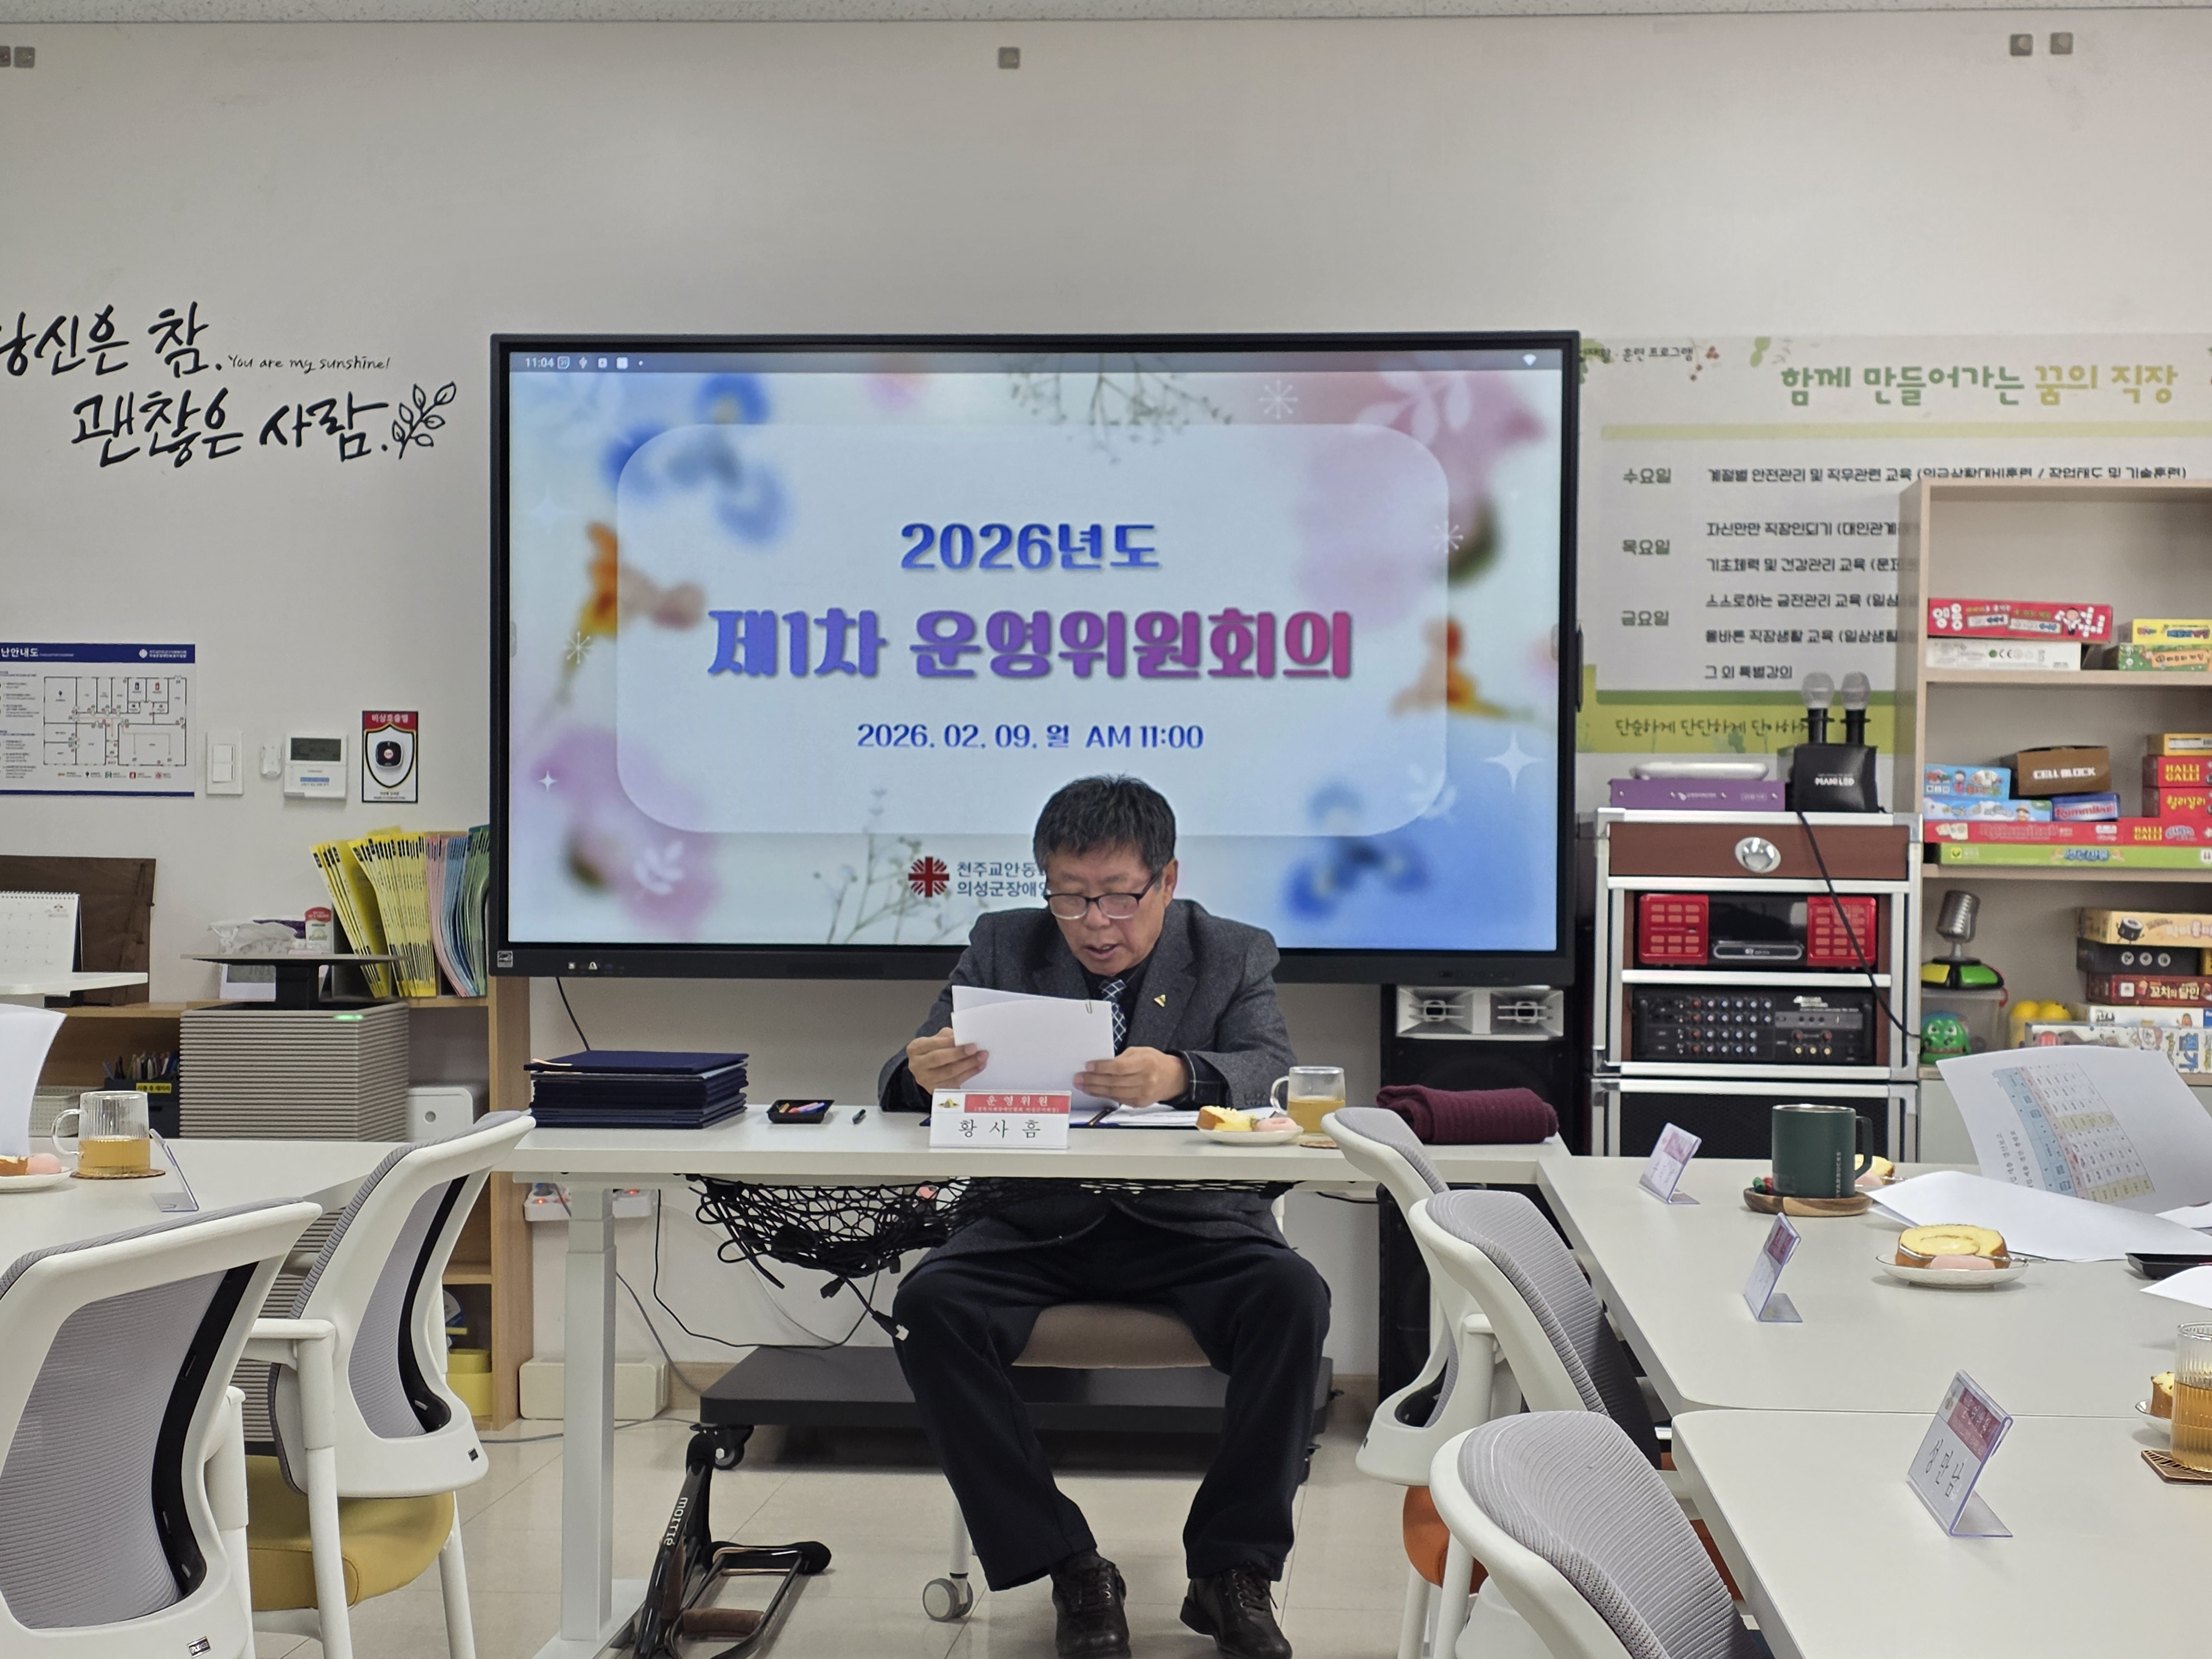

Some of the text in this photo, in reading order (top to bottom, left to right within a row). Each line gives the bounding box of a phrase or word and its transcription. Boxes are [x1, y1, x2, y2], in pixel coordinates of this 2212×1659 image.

[228, 354, 253, 368] You
[259, 359, 283, 369] are
[289, 359, 316, 374] my
[524, 356, 555, 369] 11:04
[1781, 364, 2178, 406] 함께 만들어가는 꿈의 직장
[71, 386, 244, 469] 괜찮은
[1623, 468, 1671, 484] 수요일
[1751, 468, 1806, 483] 안전관리
[1809, 468, 1823, 483] 및
[1827, 468, 1881, 482] 직무관련
[1884, 465, 1913, 484] 교육
[899, 520, 1161, 572] 2026년도
[1622, 539, 1670, 555] 목요일
[1781, 558, 1835, 572] 건강관리
[1839, 558, 1866, 572] 교육
[1705, 593, 1773, 608] 스스로하는
[1835, 593, 1861, 608] 교육
[1621, 611, 1669, 627] 금요일
[707, 607, 1354, 679] 제1차 운영위원회의
[1749, 629, 1803, 643] 직장생활
[1807, 629, 1834, 644] 교육
[1704, 665, 1718, 680] 그
[858, 724, 1037, 749] 2026. 02. 09.
[1047, 724, 1203, 749] 월 AM 11:00
[957, 861, 1046, 878] 천주교안동
